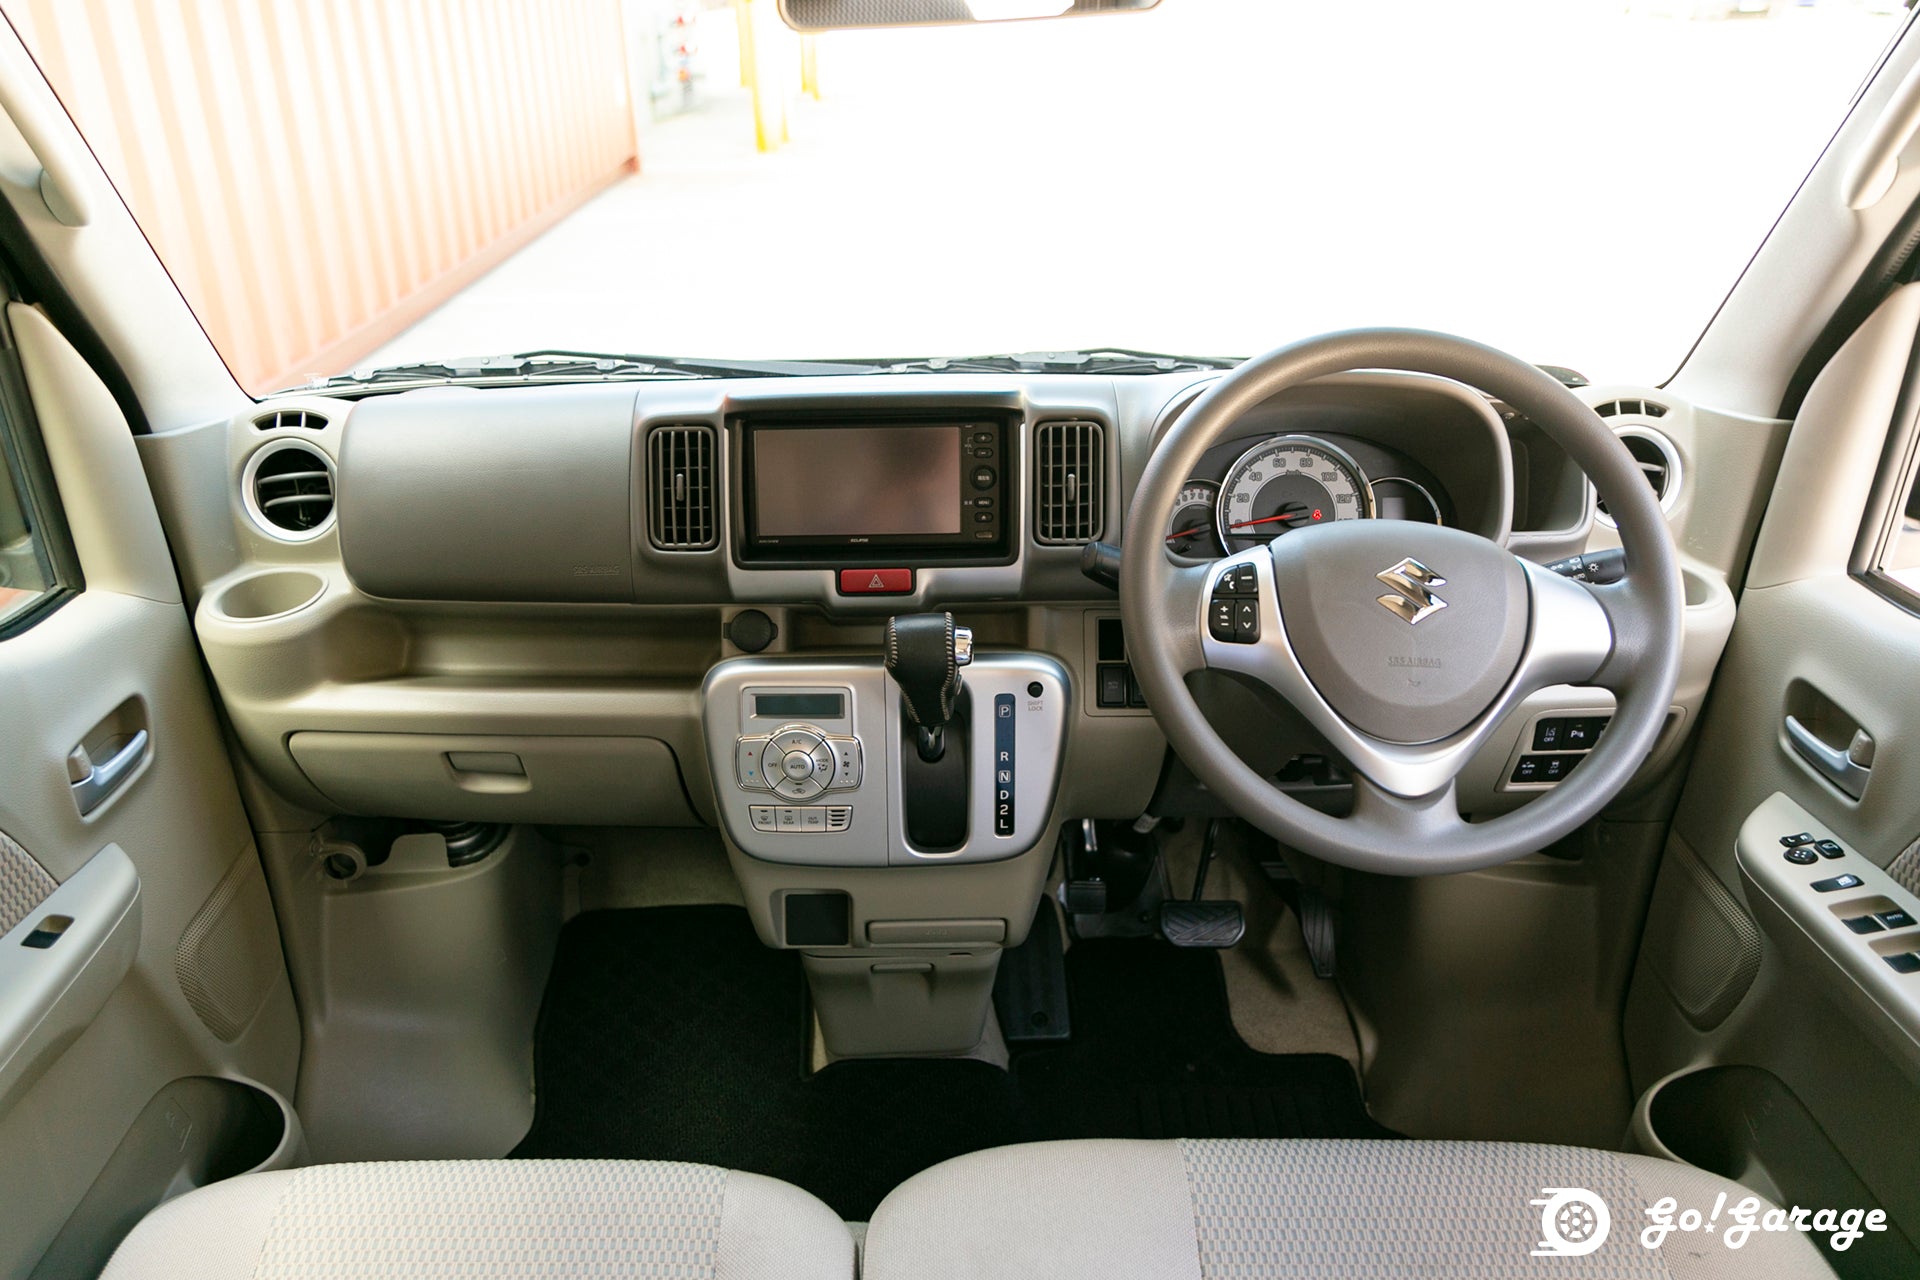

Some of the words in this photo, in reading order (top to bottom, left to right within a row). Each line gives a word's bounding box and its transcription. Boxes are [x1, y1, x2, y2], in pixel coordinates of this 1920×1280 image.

[1273, 458, 1286, 468] 60
[1299, 457, 1313, 467] 80
[1249, 472, 1262, 482] 40
[1321, 472, 1337, 481] 100
[1236, 493, 1250, 503] 20
[1336, 493, 1352, 503] 120
[1000, 751, 1009, 761] R
[1000, 772, 1009, 781] N
[1000, 790, 1009, 800] D
[1000, 804, 1008, 815] 2
[1000, 819, 1008, 829] L
